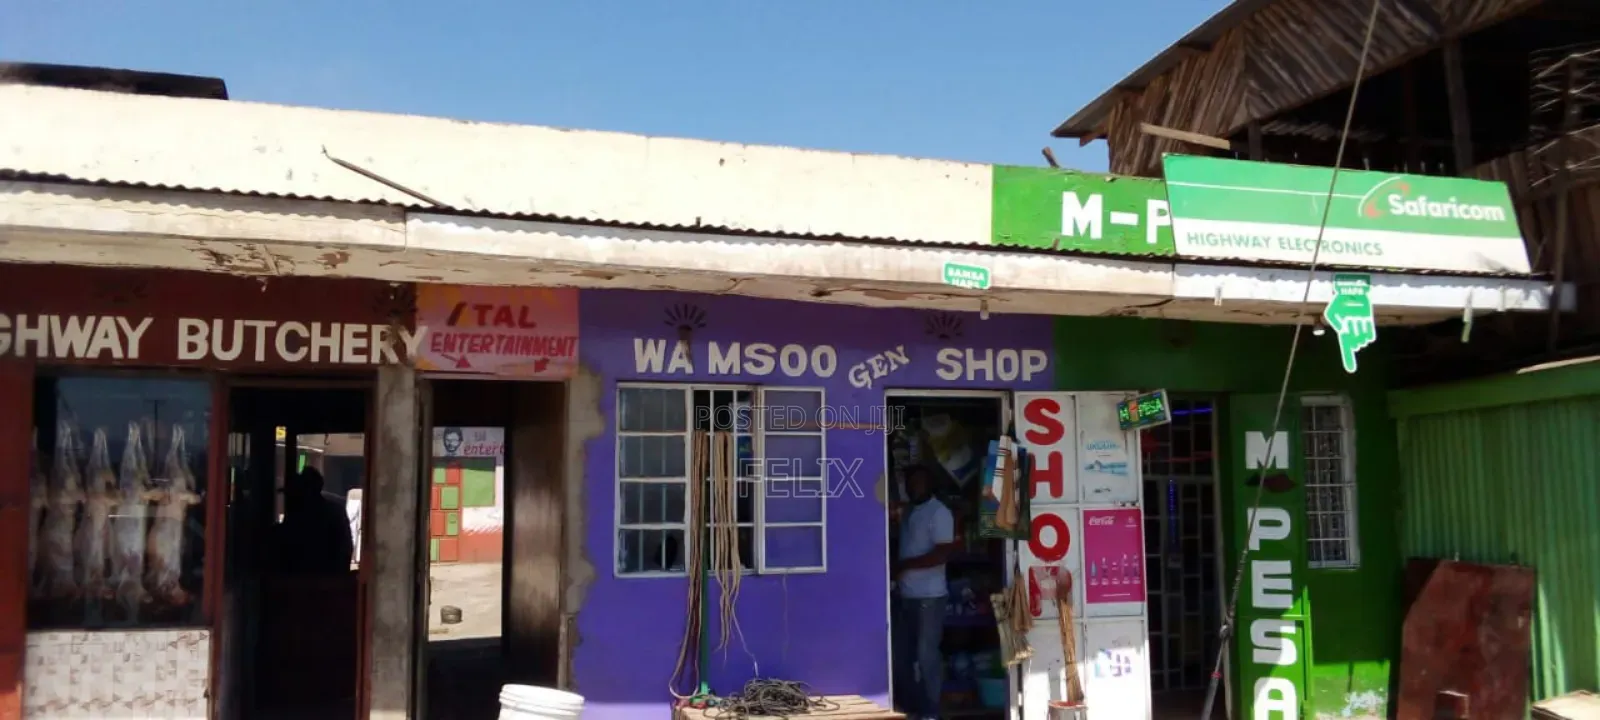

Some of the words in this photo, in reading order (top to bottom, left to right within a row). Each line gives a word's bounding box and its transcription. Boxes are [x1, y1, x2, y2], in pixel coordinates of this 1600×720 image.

[1388, 194, 1506, 221] Safaricom
[1187, 232, 1271, 249] HIGHWAY
[1278, 236, 1383, 256] ELECTRONICS
[178, 318, 428, 364] BUTCHERY
[431, 332, 578, 357] ENTERTAINMENT
[848, 345, 910, 389] GEN
[936, 348, 1048, 381] SHOP
